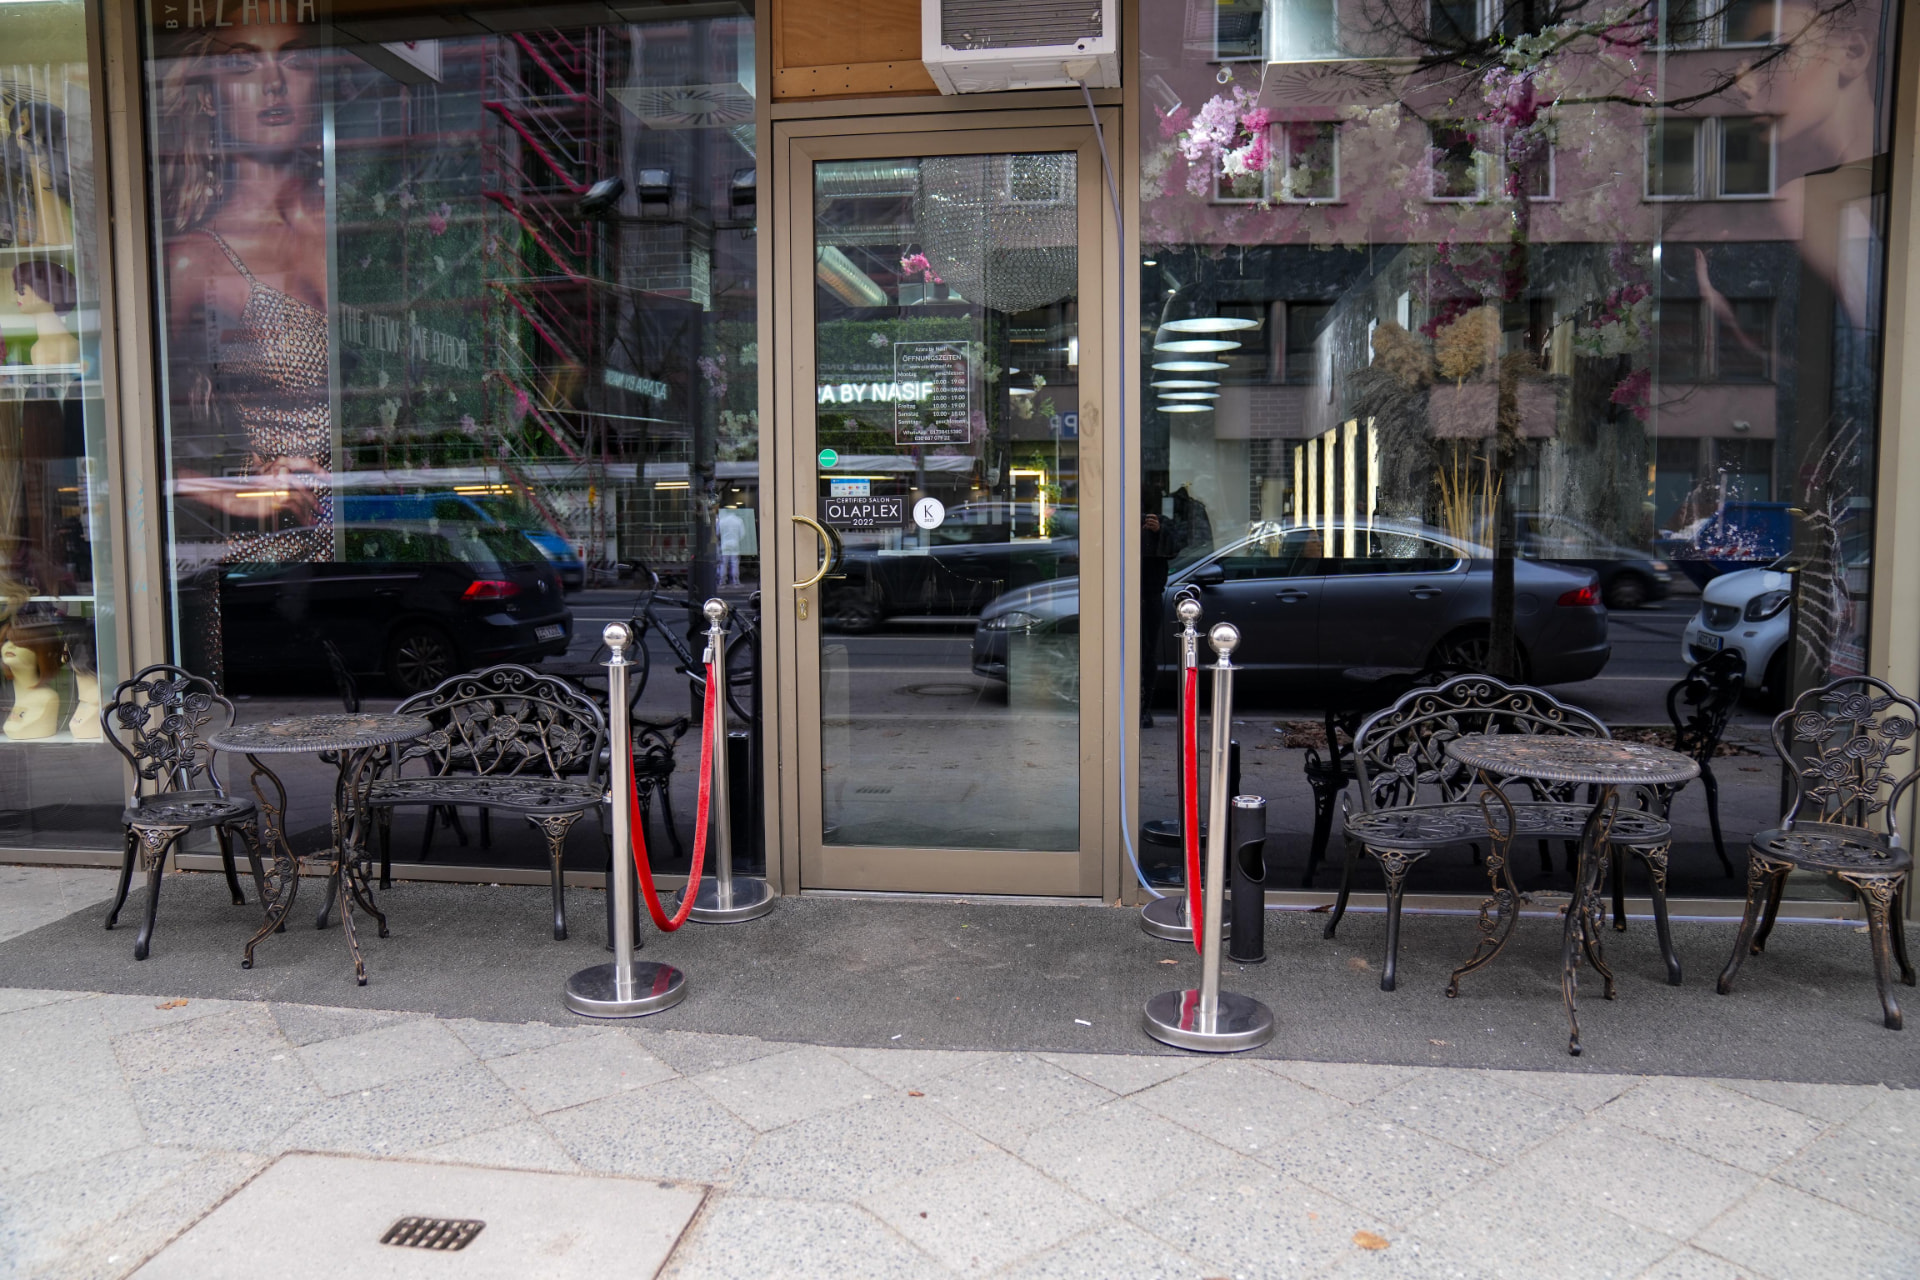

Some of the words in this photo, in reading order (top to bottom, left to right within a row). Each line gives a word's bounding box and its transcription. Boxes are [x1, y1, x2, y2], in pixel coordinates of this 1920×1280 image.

[165, 4, 179, 29] BY
[340, 302, 365, 346] THE
[432, 330, 469, 371] AZARA
[902, 354, 962, 362] ÖFFNUNGSZEITEN
[818, 384, 836, 403] A
[840, 383, 866, 403] BY
[872, 382, 932, 402] NASIF
[828, 504, 899, 518] OLAPLEX
[924, 504, 933, 518] K
